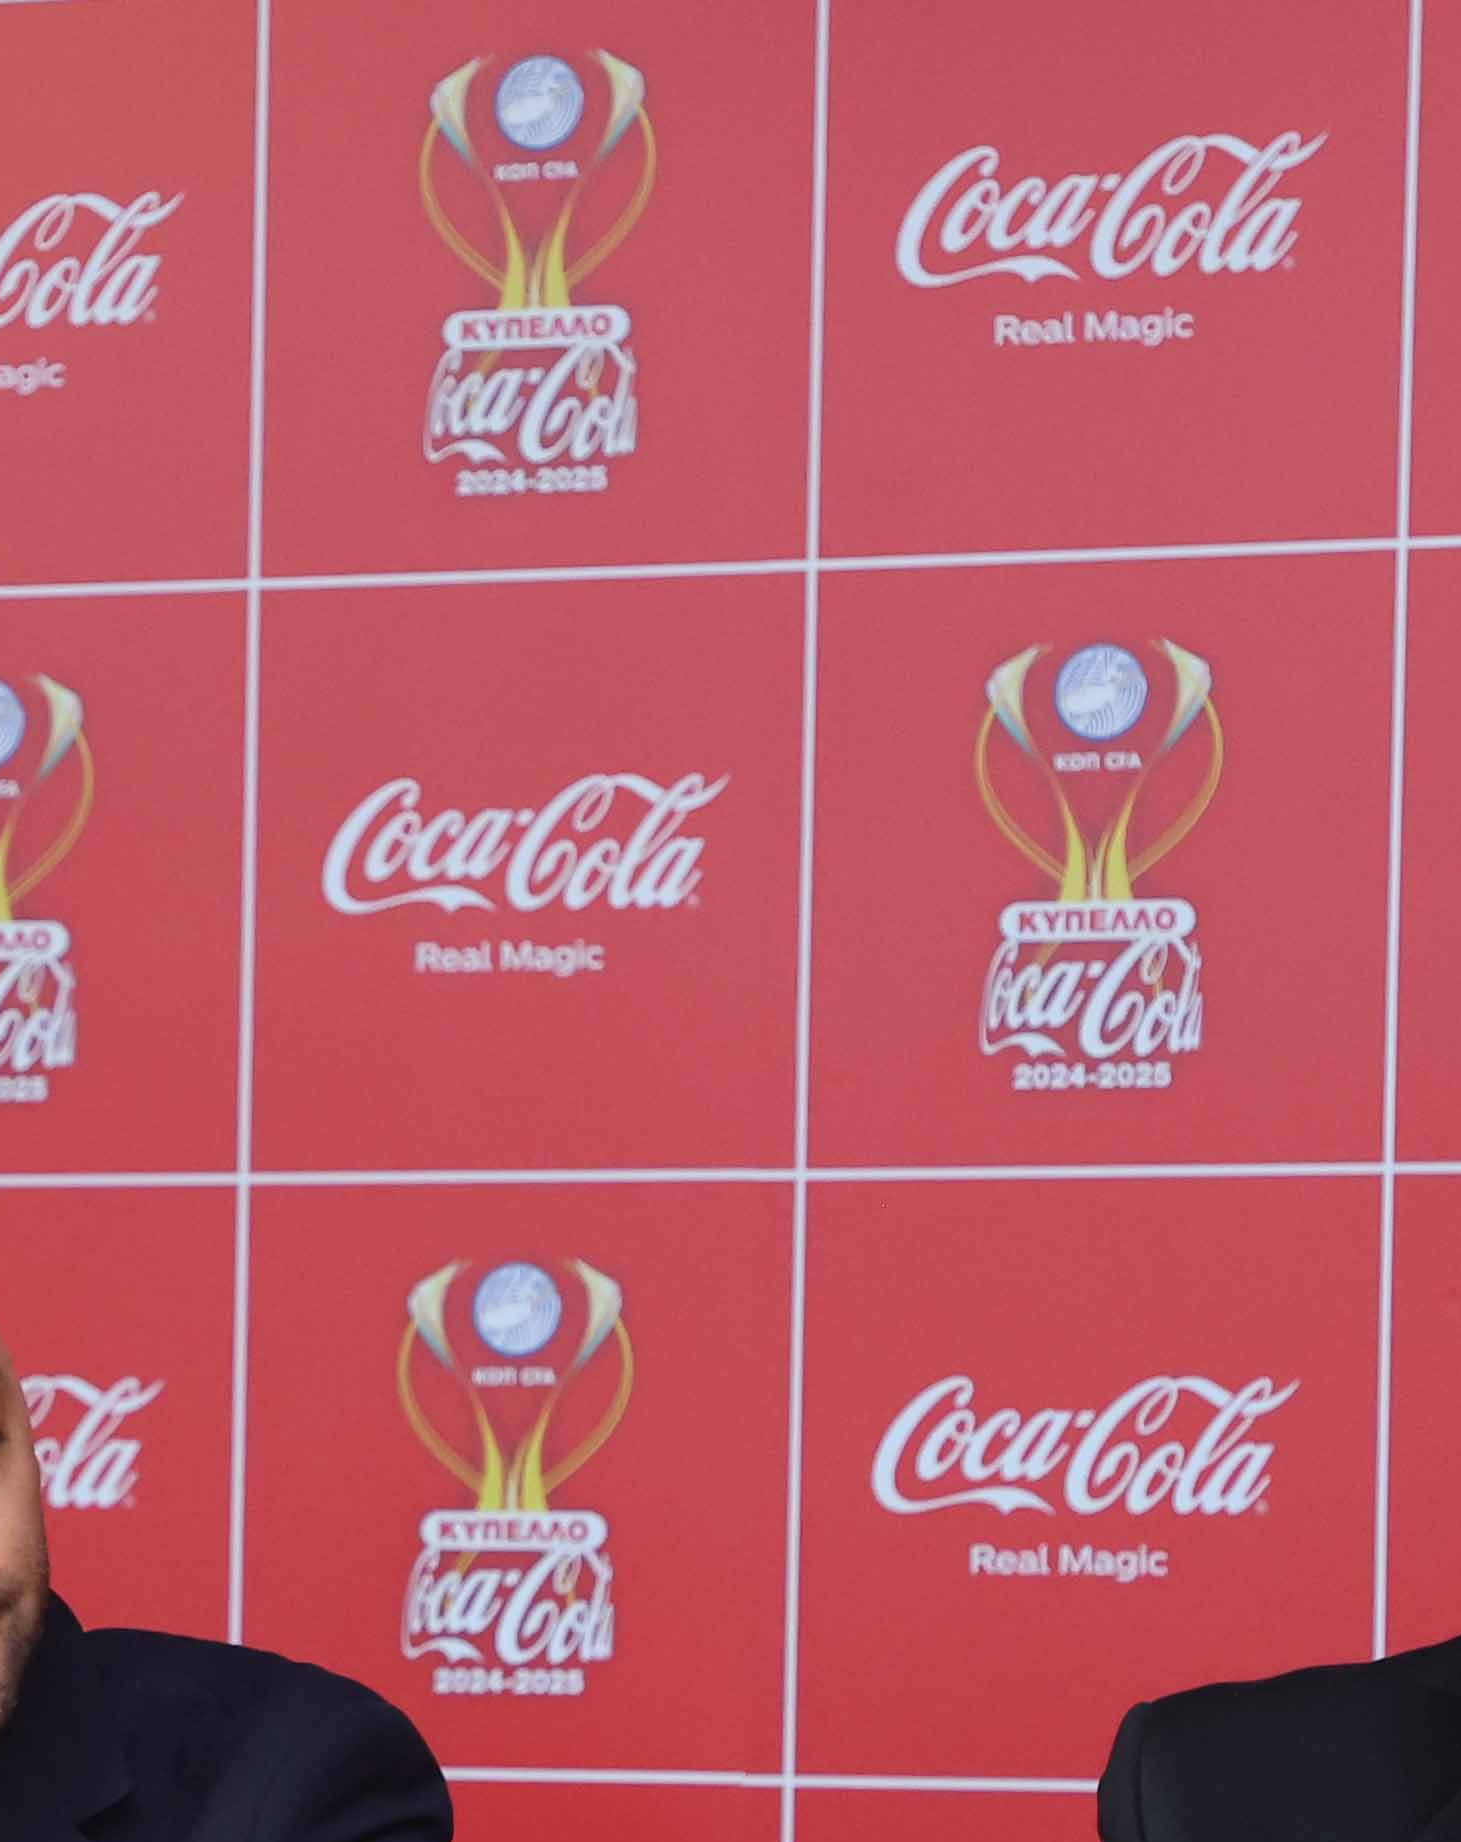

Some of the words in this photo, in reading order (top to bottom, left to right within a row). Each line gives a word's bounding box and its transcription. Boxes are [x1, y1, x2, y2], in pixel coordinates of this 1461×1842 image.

[896, 132, 1328, 287] Coca-Cola
[459, 315, 615, 344] ΚΥΠΕΛΛΟ
[994, 312, 1075, 346] Real
[1084, 307, 1194, 346] Magic
[456, 465, 608, 496] 2024-2025
[322, 773, 728, 914] Coca-Cola
[1016, 906, 1178, 933] ΚΥΠΕΛΛΟ
[416, 941, 492, 972] Real
[500, 939, 604, 977] Magic
[1014, 1062, 1171, 1089] 2024-2025
[872, 1376, 1299, 1514] Coca-Cola
[435, 1519, 594, 1546] ΚΥΠΕΛΛΟ
[970, 1543, 1050, 1575] Real
[1058, 1544, 1168, 1582] Magic
